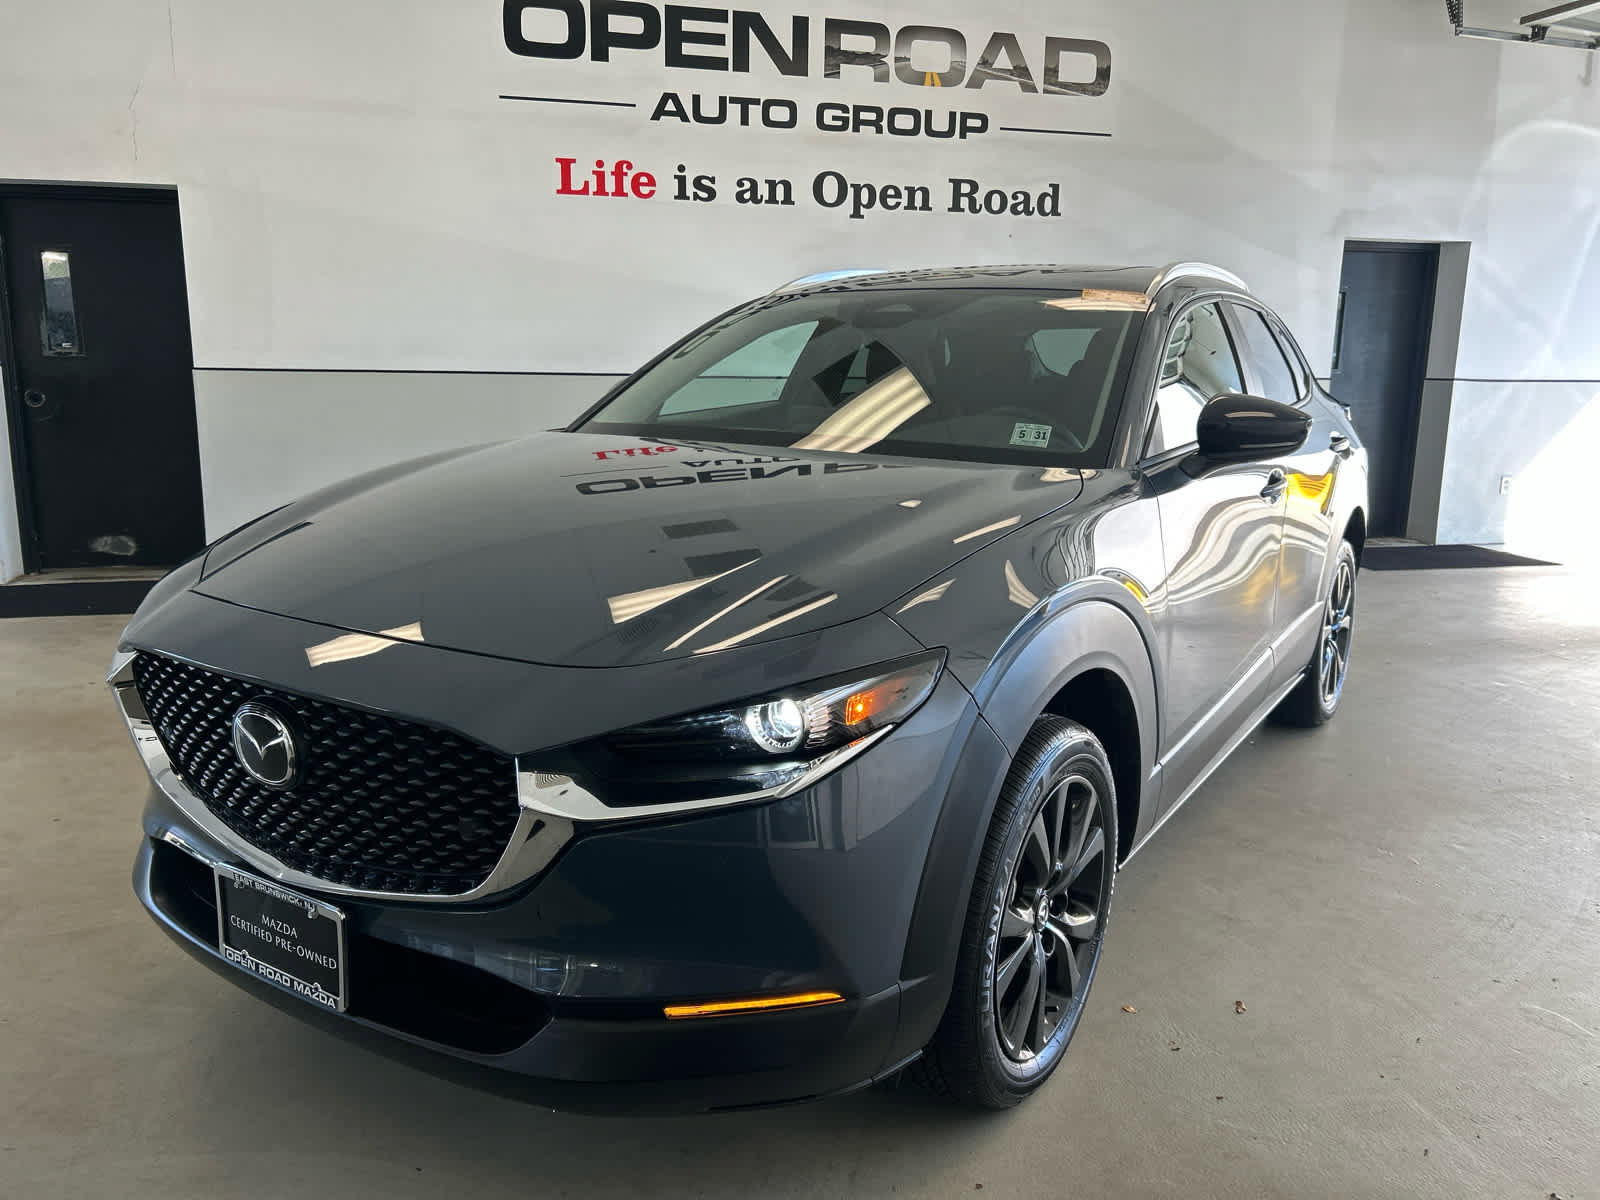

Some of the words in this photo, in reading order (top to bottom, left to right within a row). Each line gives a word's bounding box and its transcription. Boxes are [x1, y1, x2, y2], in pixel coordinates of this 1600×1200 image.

[503, 0, 809, 77] OPEN
[823, 17, 1112, 97] ROAD
[650, 92, 798, 129] AUTO
[816, 102, 989, 139] GROUP
[555, 157, 657, 199] Life
[673, 164, 717, 202] is
[735, 176, 795, 205] an
[812, 170, 932, 219] Open
[947, 178, 1061, 217] Road
[230, 914, 272, 943] CERTIFIED
[275, 936, 337, 969] PRE-OWNED
[261, 914, 298, 939] MAZDA
[226, 950, 256, 970] OPEN
[259, 965, 291, 987] ROAD
[294, 981, 336, 1009] MAZDA
